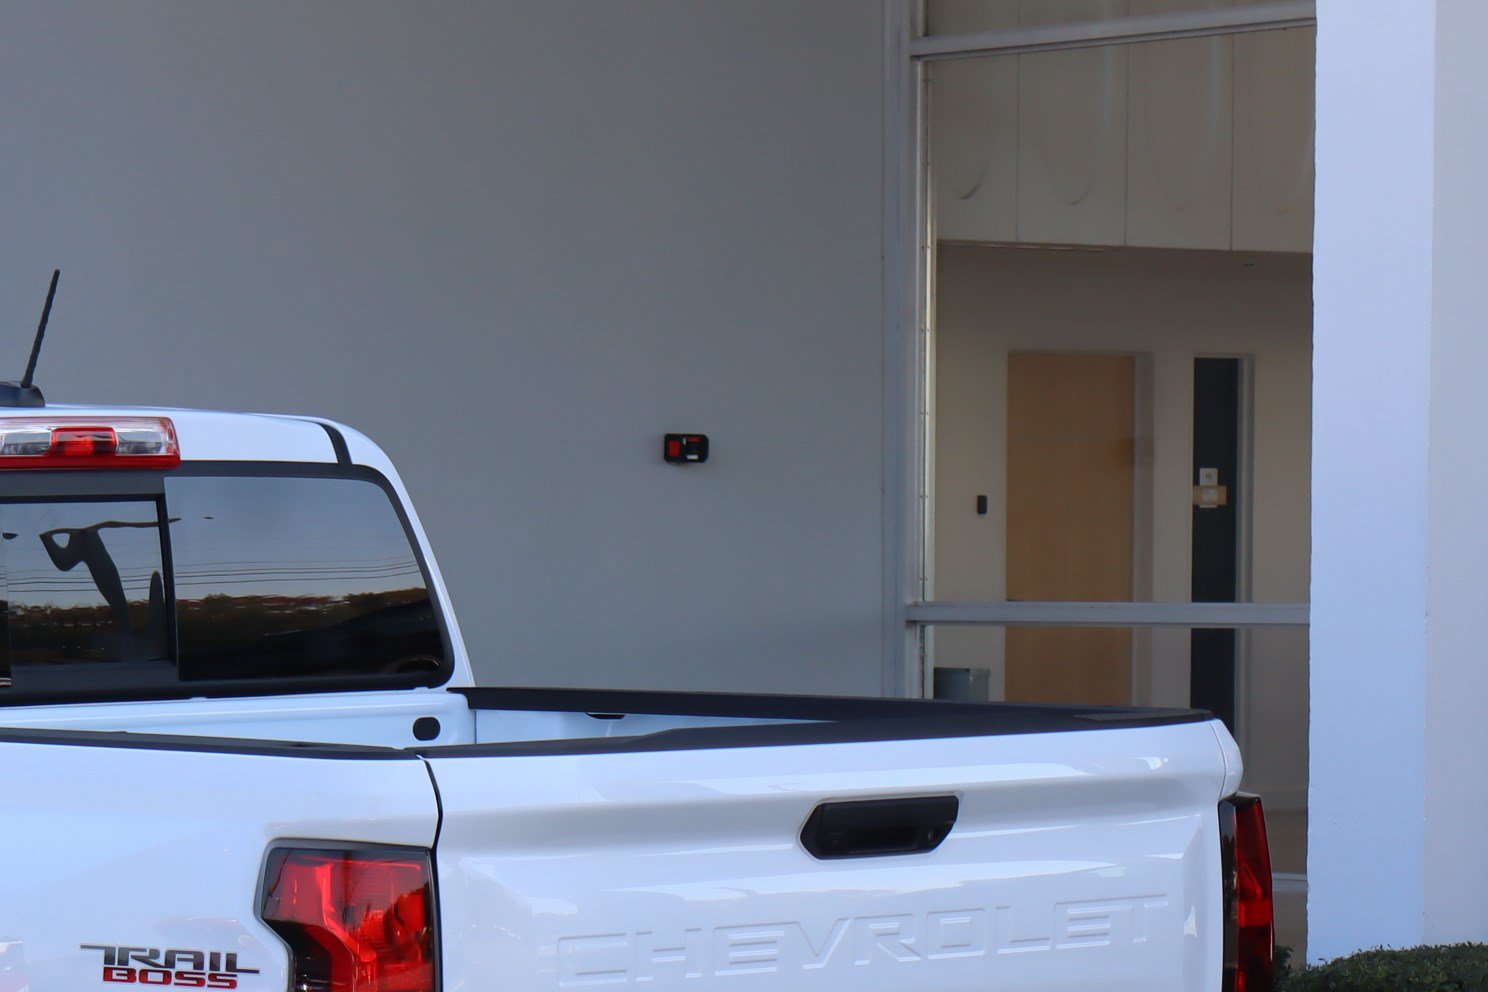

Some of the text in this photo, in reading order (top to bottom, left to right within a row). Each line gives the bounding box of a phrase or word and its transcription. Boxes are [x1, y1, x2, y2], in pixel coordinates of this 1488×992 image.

[557, 893, 1170, 987] CHEVROLET
[80, 943, 260, 974] TRAIL
[102, 966, 238, 990] BOSS
